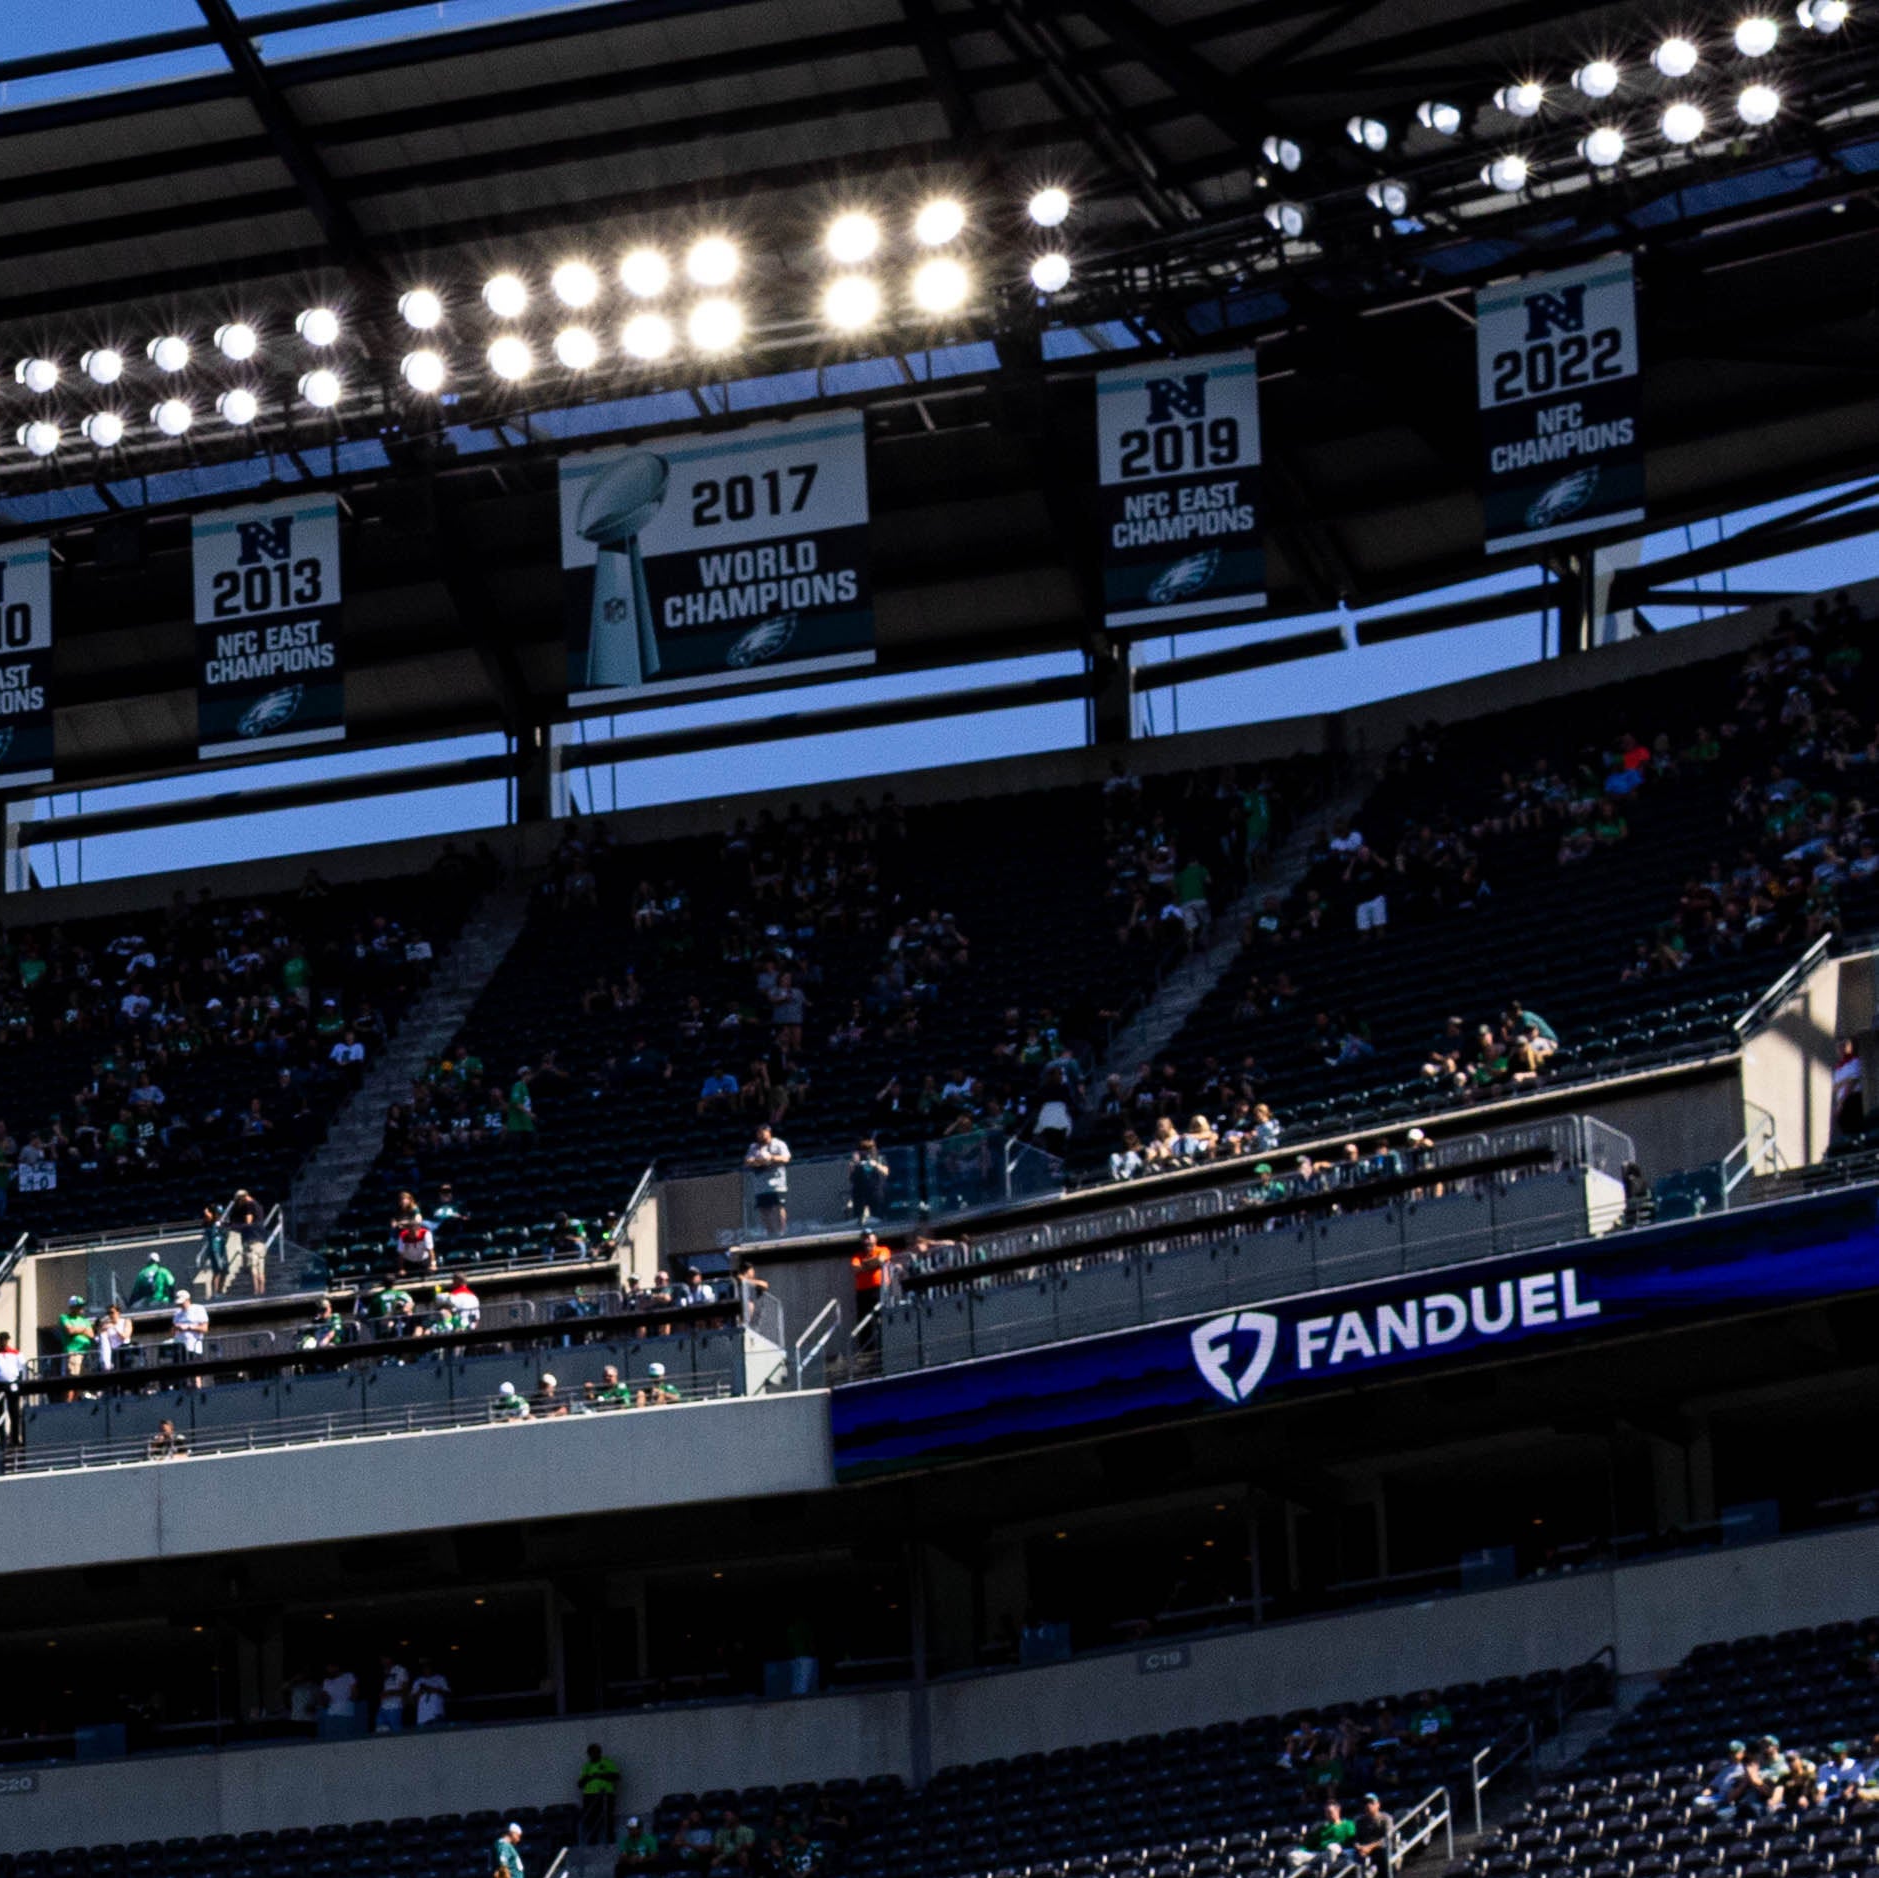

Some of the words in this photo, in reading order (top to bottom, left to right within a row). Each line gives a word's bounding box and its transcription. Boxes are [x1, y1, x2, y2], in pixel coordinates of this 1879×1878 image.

[1493, 327, 1621, 401] 2022
[1491, 418, 1634, 475] CHAMPIONS
[1536, 403, 1584, 436] NFC
[1120, 419, 1239, 478] 2019
[693, 464, 818, 527] 2017
[1124, 488, 1171, 518] NFC
[1177, 481, 1241, 509] EAST
[1112, 504, 1255, 549] CHAMPIONS
[213, 558, 322, 618] 2013
[699, 540, 818, 588] WORLD
[663, 568, 859, 629] CHAMPIONS
[205, 644, 336, 686] CHAMPIONS
[217, 630, 258, 658] NFC
[265, 620, 322, 648] EAST
[1296, 1269, 1601, 1370] FANDUEL
